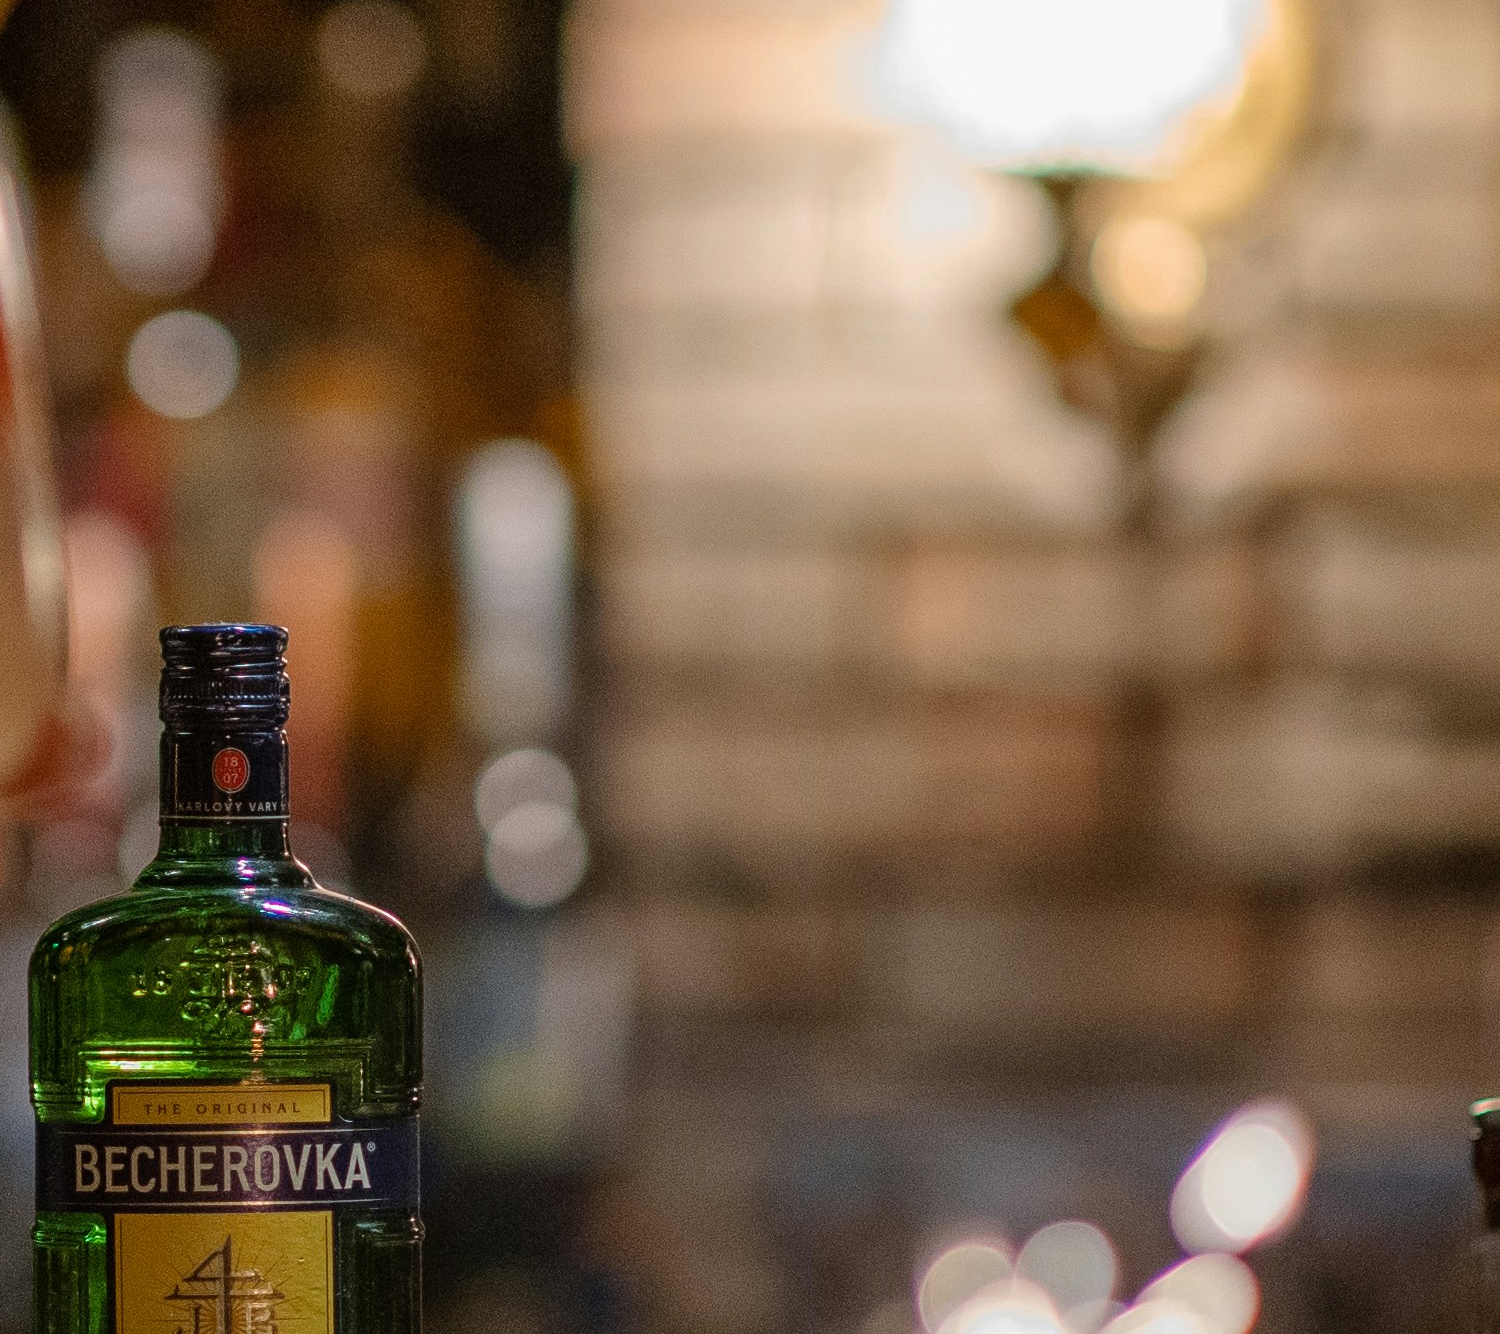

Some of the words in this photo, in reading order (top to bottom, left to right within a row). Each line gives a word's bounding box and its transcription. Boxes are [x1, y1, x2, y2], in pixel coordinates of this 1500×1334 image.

[224, 756, 239, 768] 18
[223, 772, 239, 784] 07
[178, 801, 243, 812] KARLOVY
[248, 801, 278, 812] VARY
[143, 1103, 182, 1115] THE
[196, 1102, 301, 1115] ORIGINAL
